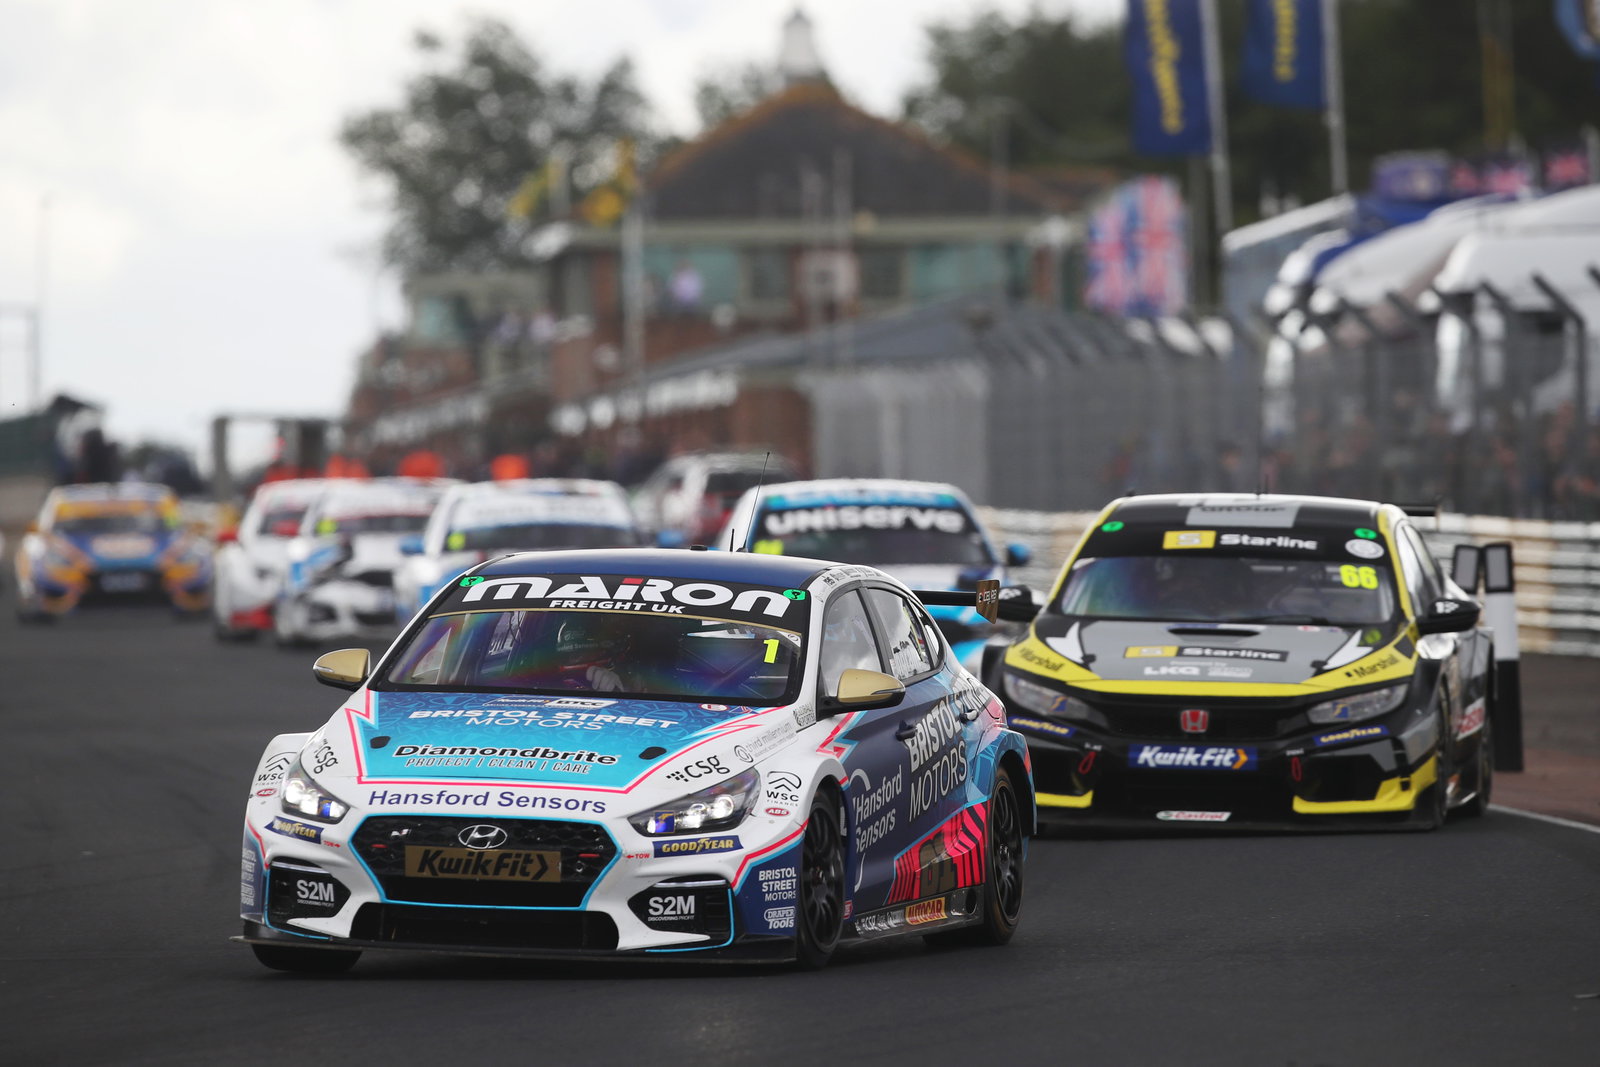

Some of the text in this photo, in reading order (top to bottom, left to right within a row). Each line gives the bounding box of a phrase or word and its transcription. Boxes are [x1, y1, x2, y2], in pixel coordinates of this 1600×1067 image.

[1219, 532, 1318, 551] Starline
[1339, 564, 1379, 590] 66
[549, 599, 687, 614] FREIGHT UK
[763, 638, 780, 664] 1
[1182, 646, 1282, 660] Starline
[408, 709, 680, 729] BRISTOL STREET
[465, 717, 605, 731] MOTORS
[904, 695, 962, 773] BRISTOL
[1320, 727, 1382, 744] GOODYEAR
[393, 744, 621, 765] Diamondbrite
[405, 757, 593, 774] PROTECT CLEAN CARE
[908, 741, 967, 823] MOTORS
[367, 790, 607, 814] Hansford Sensors
[766, 790, 799, 802] WSC
[854, 764, 902, 826] Hansford
[855, 808, 897, 854] Sensors
[661, 838, 735, 854] GOODYEAR
[758, 867, 797, 881] BRISTOL
[296, 879, 335, 903] S2M
[761, 878, 797, 893] STREET
[764, 890, 797, 902] MOTORS
[647, 895, 696, 917] S2M
[767, 908, 796, 919] DRAPER
[907, 898, 944, 924] AUTOCAR
